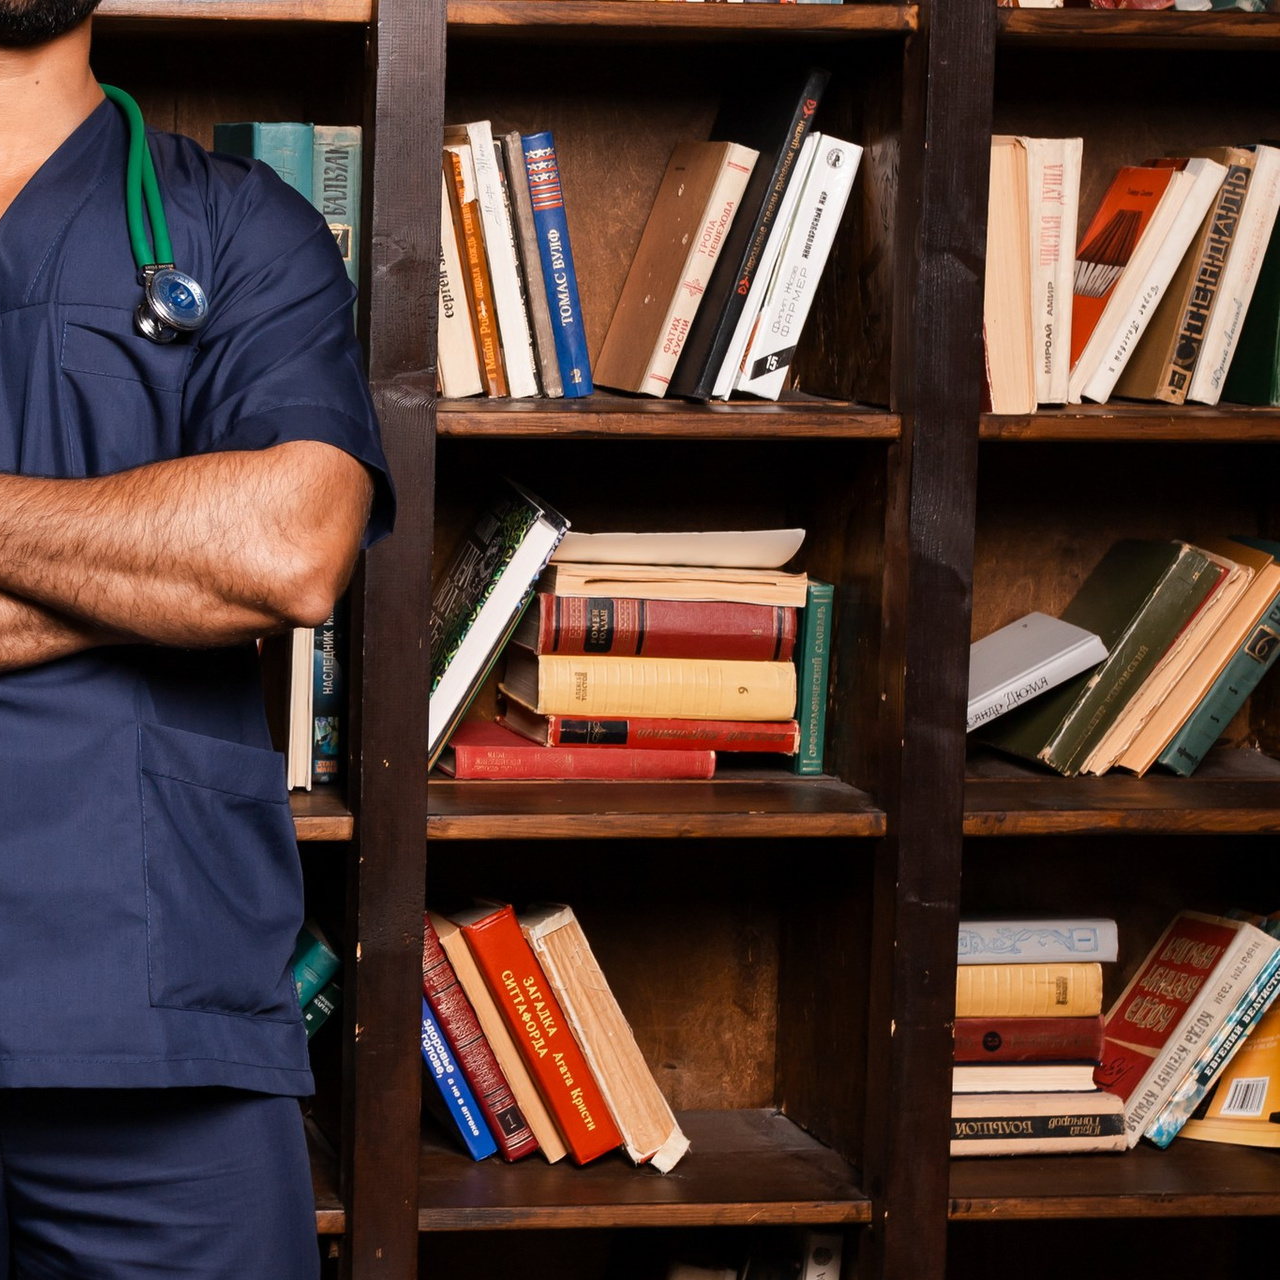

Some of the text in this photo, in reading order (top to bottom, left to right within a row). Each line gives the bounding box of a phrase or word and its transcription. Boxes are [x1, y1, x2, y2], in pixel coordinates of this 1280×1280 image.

[322, 144, 348, 217] БАЛЬЗАК
[741, 118, 807, 277] Народные песни русских цыган
[697, 218, 717, 256] ТРОПА
[706, 199, 735, 259] ПЕШЕХОДА
[1039, 162, 1066, 267] ЧИСТАЯ ДУША
[466, 230, 479, 258] ВОЖДЬ
[1172, 166, 1251, 369] СТЕНДАЛЬ
[546, 227, 574, 326] ТОМАС ВУЛФ
[779, 266, 809, 338] ФАРМЕР
[1045, 280, 1054, 317] АМИР
[479, 335, 496, 370] Майн
[662, 315, 682, 354] ФАТИХ
[671, 318, 690, 357] ХУСНИ
[1112, 319, 1141, 363] Полевой
[766, 354, 779, 372] 15
[589, 608, 601, 643] РОМЕН
[323, 629, 335, 694] НАСЛЕДНИК
[807, 605, 827, 756] ОРФОГРАФИЧЕСКИЙ СЛОВАРЬ
[500, 968, 549, 1058] СИТТАФОРДА
[521, 974, 558, 1037] ЗАГАДКА
[418, 1030, 448, 1079] голове,
[422, 1016, 456, 1075] здоровье
[1151, 1042, 1192, 1092] КРЕПНУТ
[1202, 1023, 1245, 1077] ЕВГЕНИЙ
[450, 1083, 463, 1098] не
[460, 1104, 480, 1137] аптеке
[551, 1049, 598, 1132] Агата Кристи
[1121, 1088, 1159, 1134] КРЫЛЬЯ
[954, 1120, 1033, 1136] БОЛЬШОЙ
[1048, 1116, 1099, 1128] Гончаров
[1070, 1125, 1100, 1135] Юрий
